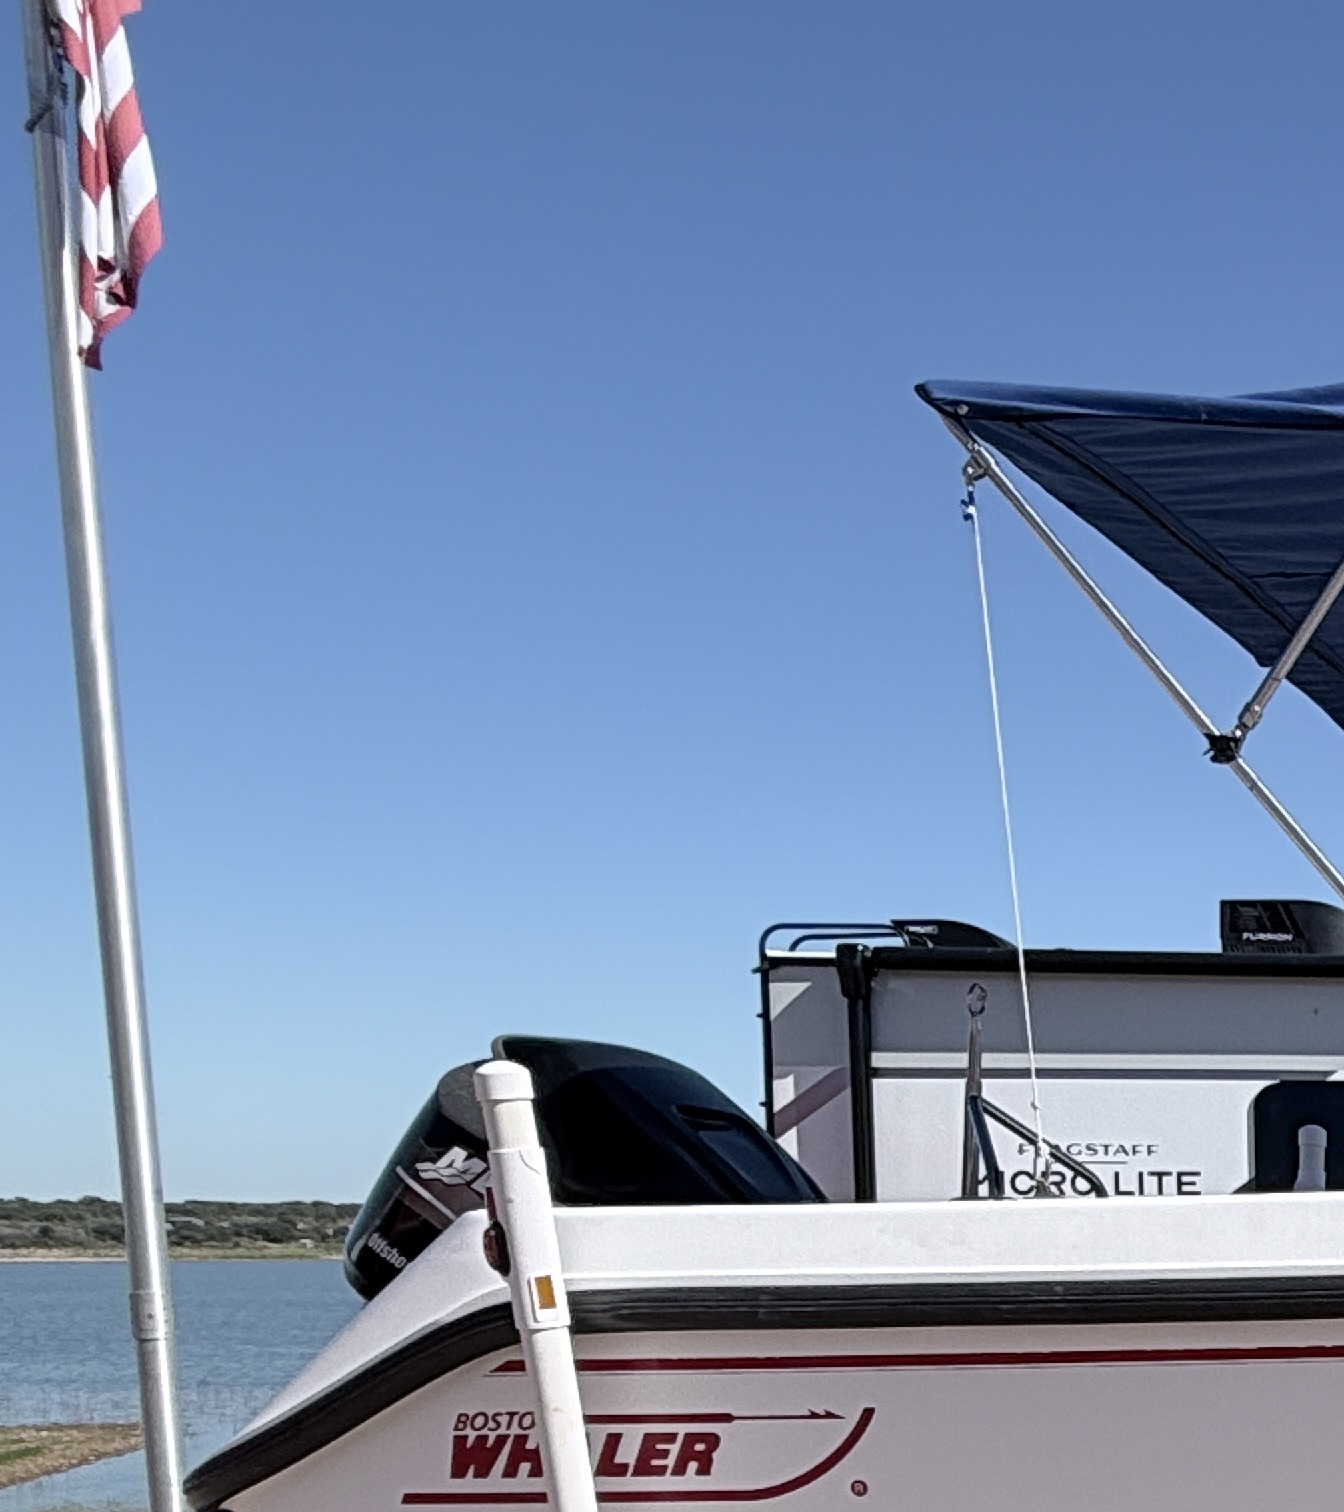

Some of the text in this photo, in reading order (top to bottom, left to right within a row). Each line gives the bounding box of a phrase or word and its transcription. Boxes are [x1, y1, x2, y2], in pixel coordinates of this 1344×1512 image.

[1015, 1142, 1160, 1157] FGSTAFF
[977, 1170, 1203, 1197] ICRO LITE
[367, 1231, 409, 1269] Offsho
[453, 1411, 537, 1432] BOSTO
[449, 1432, 722, 1480] WHLER
